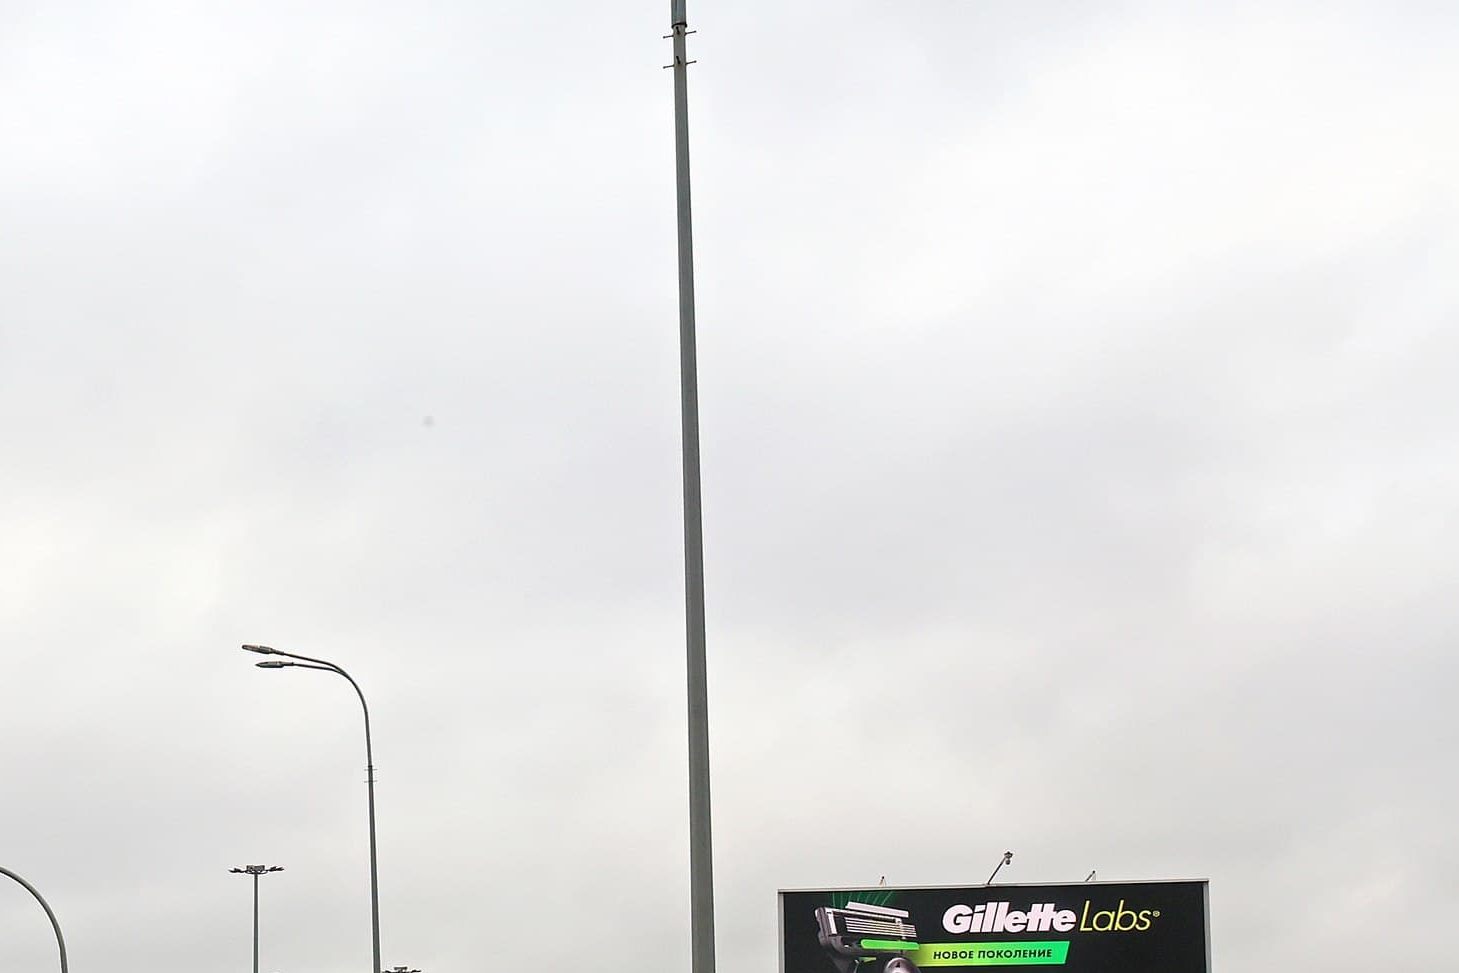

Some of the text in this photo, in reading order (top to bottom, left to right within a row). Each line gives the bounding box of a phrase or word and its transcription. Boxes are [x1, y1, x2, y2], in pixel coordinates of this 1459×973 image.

[942, 901, 1077, 934] Gillette
[933, 948, 1053, 960] НОВОЕ ПОКОЛЕНИЕ
